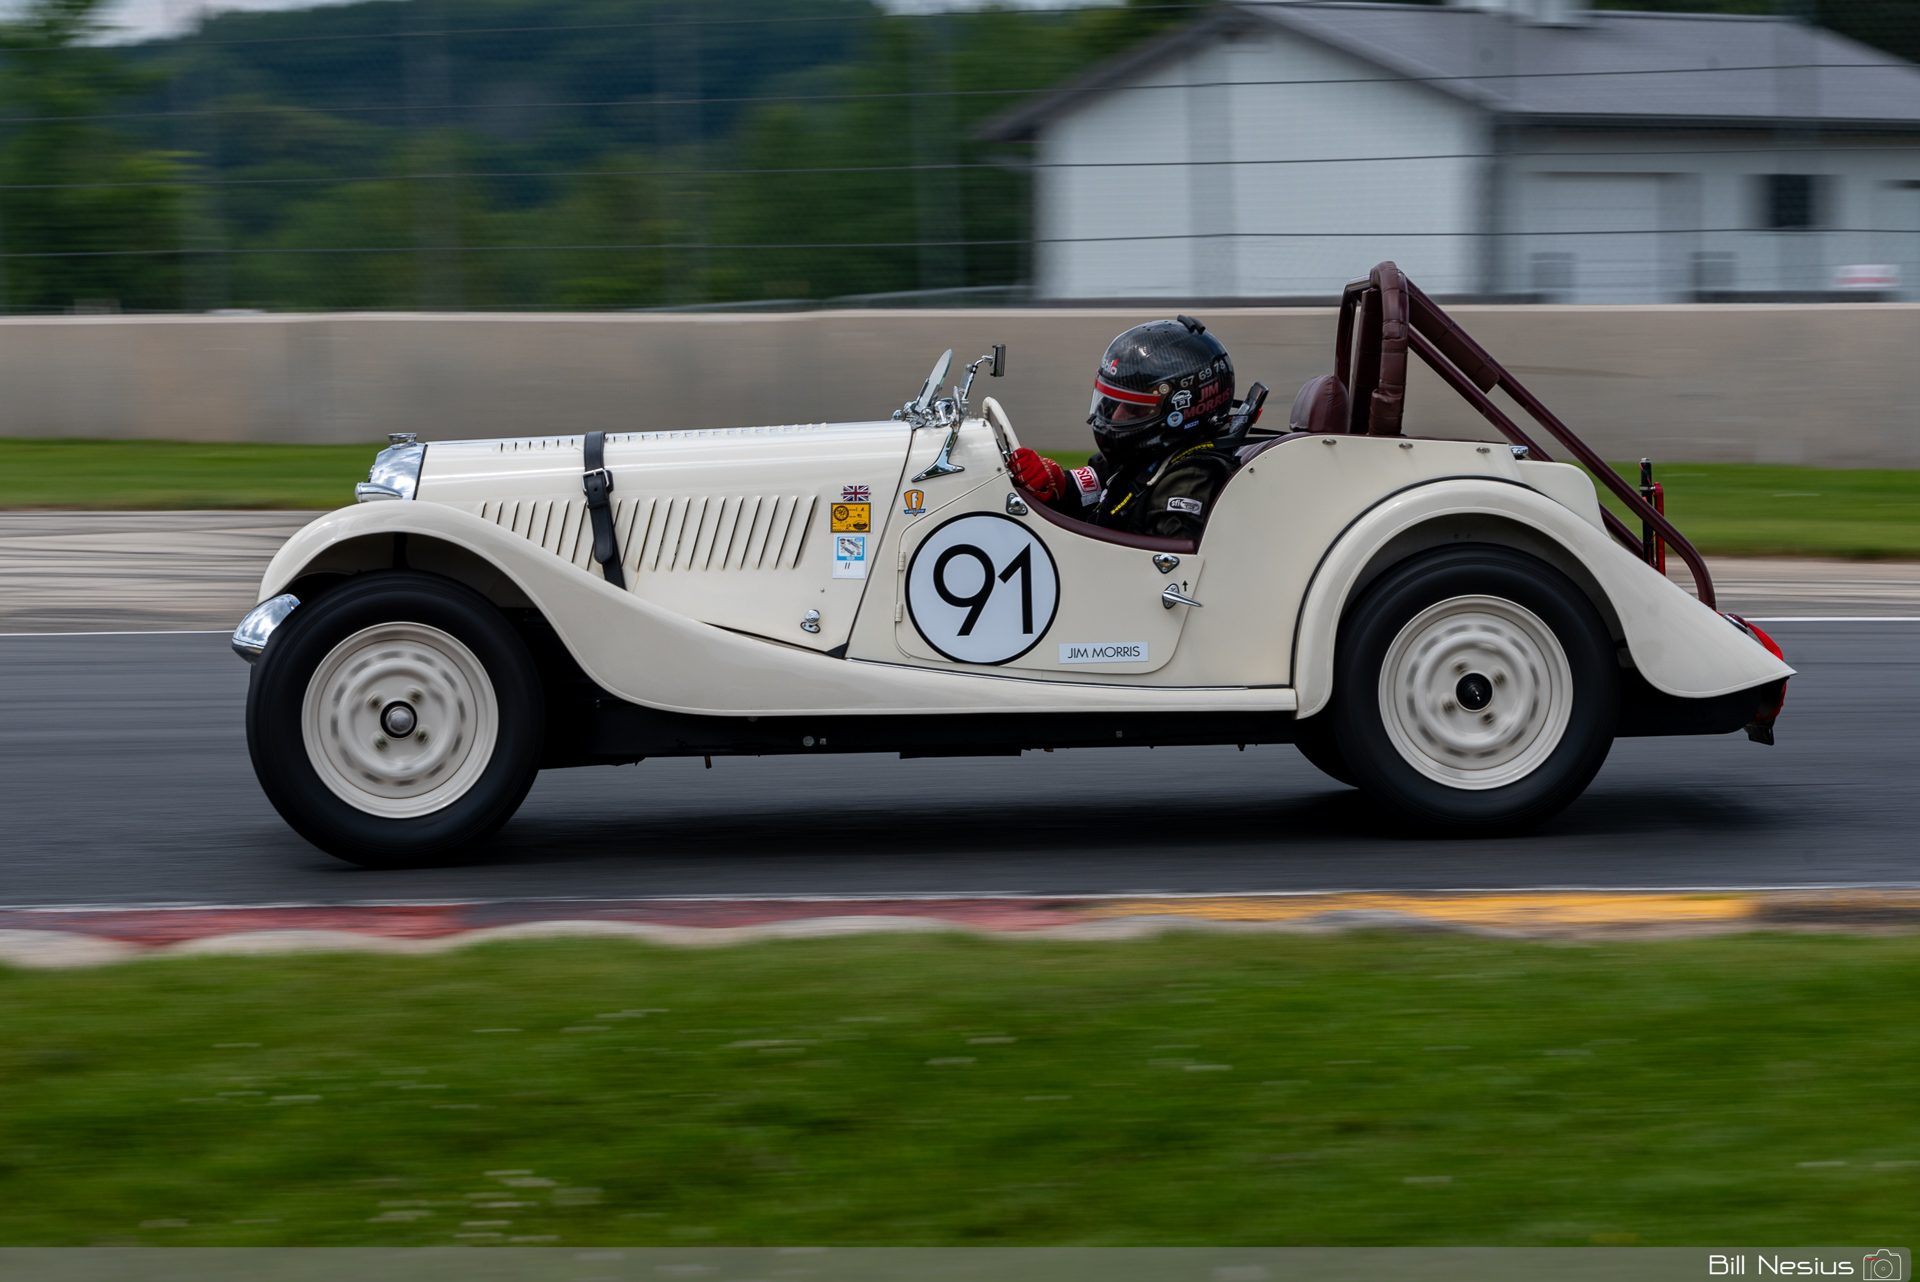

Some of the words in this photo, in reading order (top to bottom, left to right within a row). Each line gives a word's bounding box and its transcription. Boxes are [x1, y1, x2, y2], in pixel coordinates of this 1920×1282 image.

[1180, 375, 1195, 388] 67
[1198, 368, 1213, 381] 69
[1198, 381, 1219, 403] JIM
[1182, 387, 1231, 420] MORRIS
[933, 541, 1034, 636] 91
[1067, 648, 1089, 659] JIM
[1091, 646, 1141, 658] MORRIS
